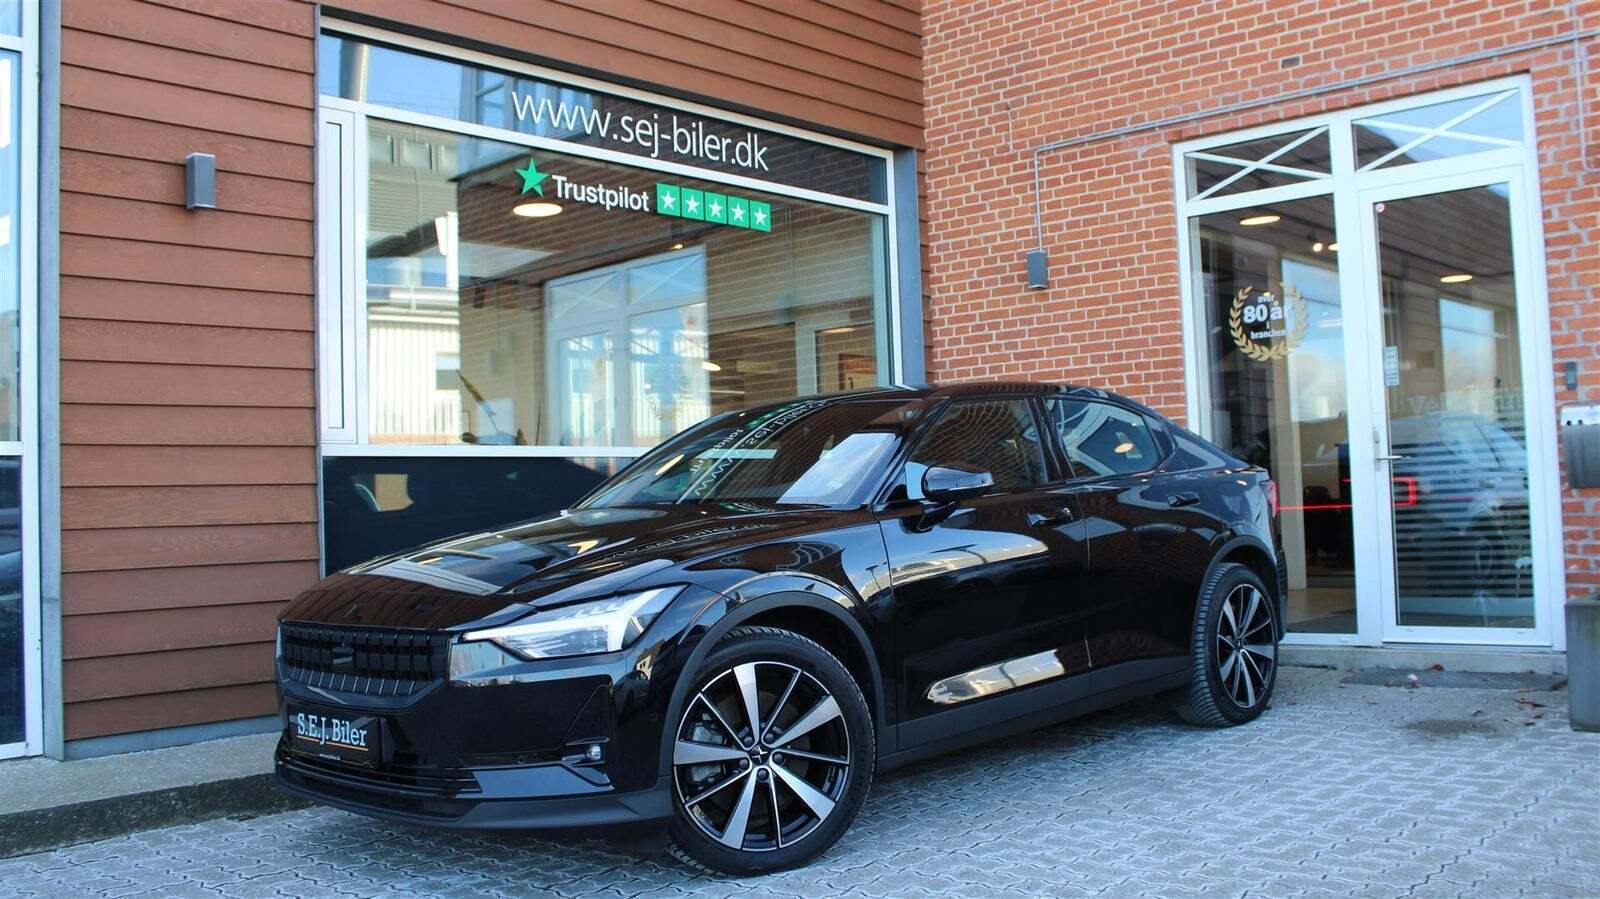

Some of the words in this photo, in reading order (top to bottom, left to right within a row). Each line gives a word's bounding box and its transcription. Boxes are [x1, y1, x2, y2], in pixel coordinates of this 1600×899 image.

[511, 91, 769, 171] www.sej-biler.dk
[551, 175, 650, 212] Trustpilot
[1243, 304, 1268, 323] 80
[1270, 300, 1289, 320] år
[1251, 329, 1287, 339] branchen
[297, 712, 329, 745] S.E.J.
[331, 718, 368, 747] Biler
